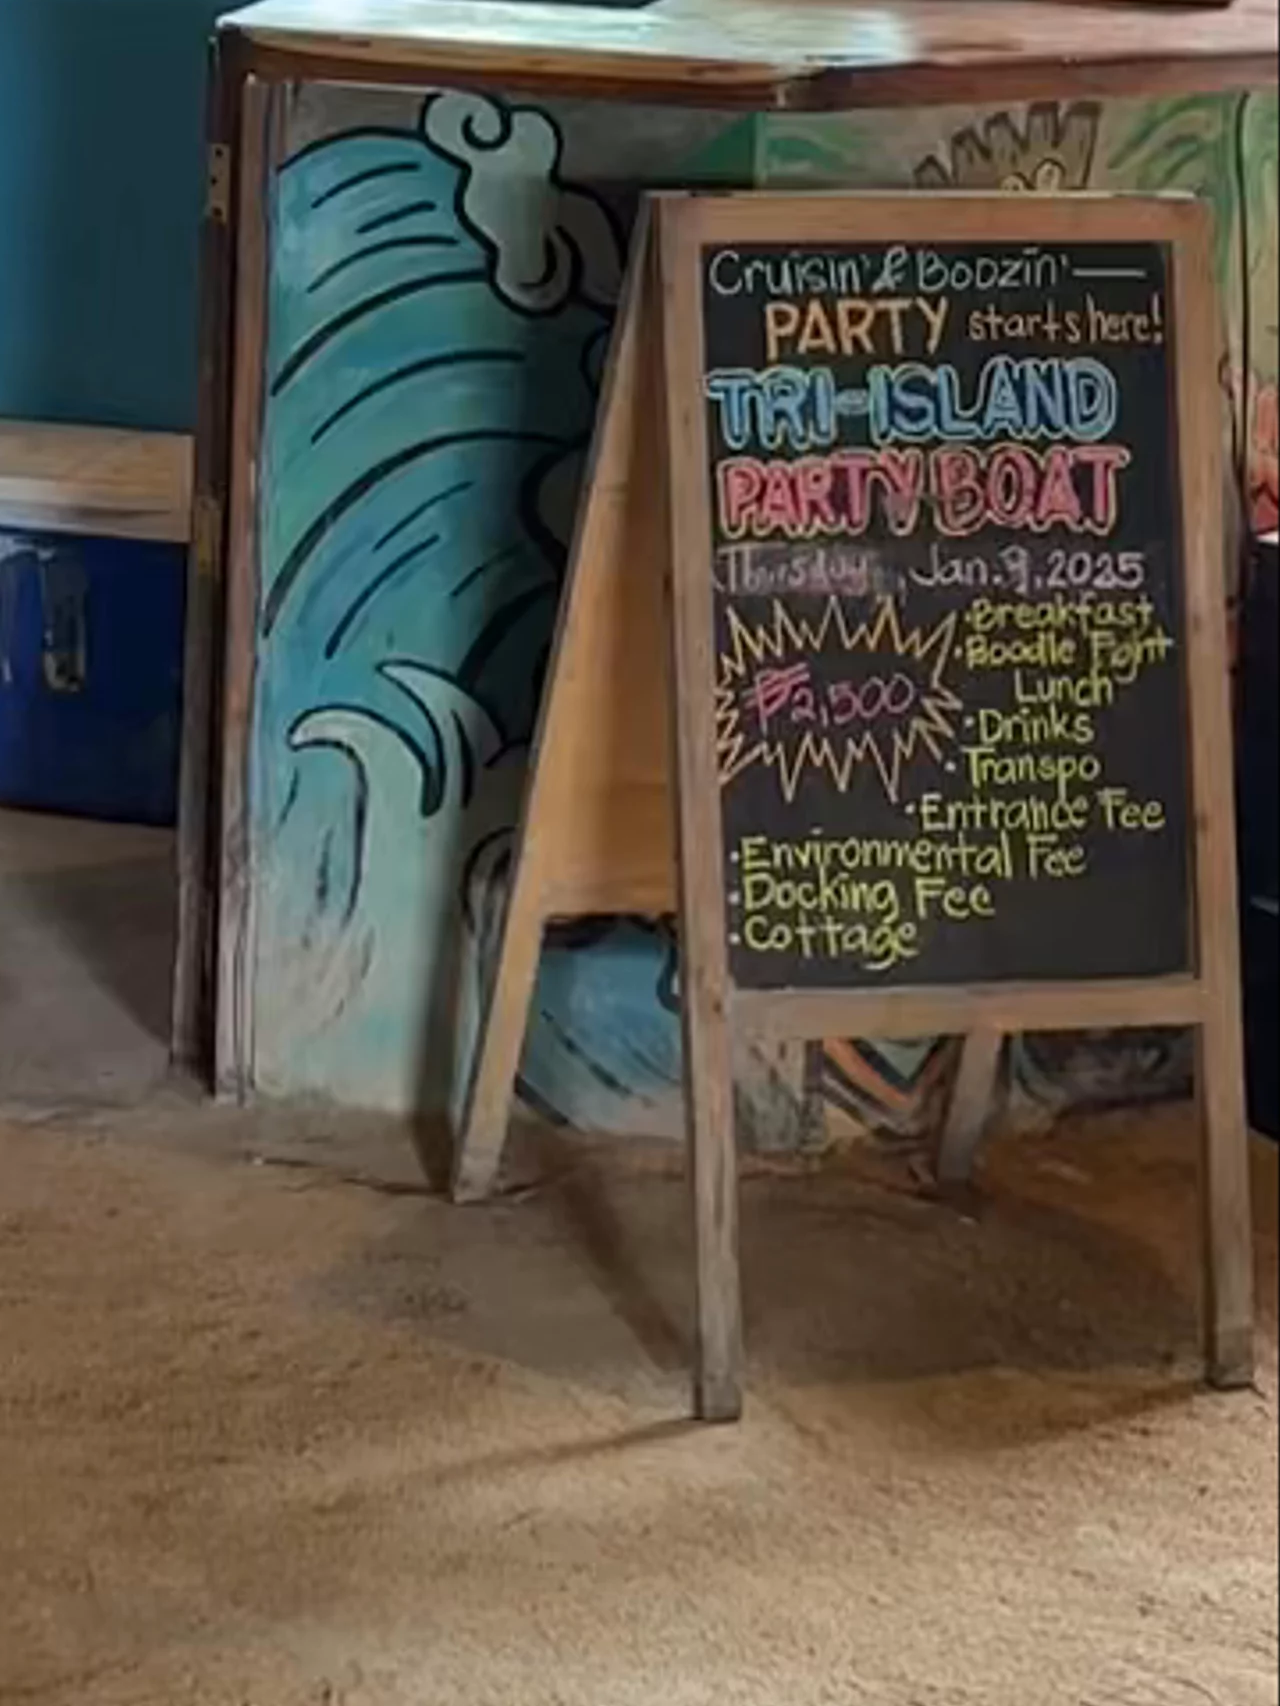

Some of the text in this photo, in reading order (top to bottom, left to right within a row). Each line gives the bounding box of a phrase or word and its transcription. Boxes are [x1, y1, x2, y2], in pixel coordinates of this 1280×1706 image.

[708, 248, 870, 296] Cruisin'
[870, 245, 909, 293] &
[764, 292, 1166, 361] PARTY starts here!
[706, 353, 1119, 451] TRI-ISLAND
[717, 443, 1131, 540] PARTY BOAT
[971, 592, 1154, 635] Breakfast
[964, 630, 1077, 670] Boodle
[1013, 668, 1114, 707] Lunch
[978, 703, 1095, 744] Drinks
[960, 746, 1102, 801] Transpo
[919, 786, 1167, 832] Entrance Fee
[742, 826, 1088, 879] Environmental Fee
[742, 870, 997, 924] Docking Fee
[743, 916, 919, 970] Cottage
